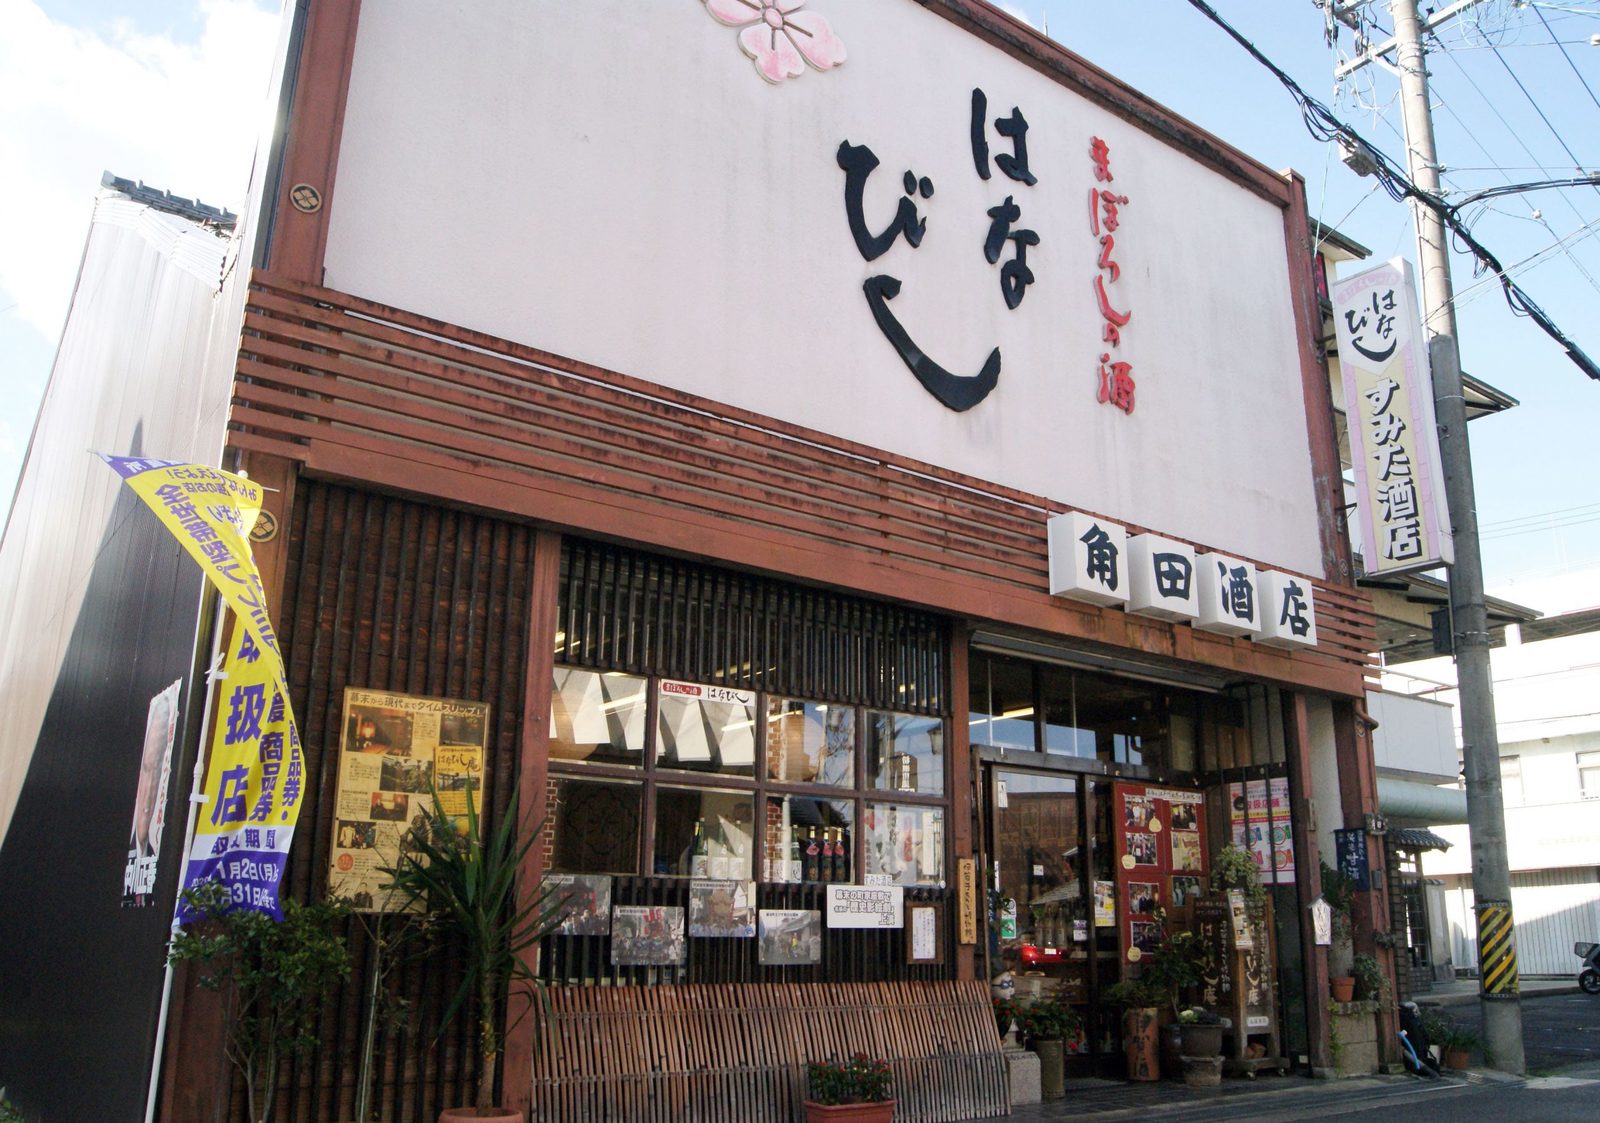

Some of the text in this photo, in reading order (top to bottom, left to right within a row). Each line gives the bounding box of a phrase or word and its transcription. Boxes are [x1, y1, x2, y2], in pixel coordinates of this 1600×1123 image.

[1364, 376, 1424, 561] すみた酒店
[1079, 522, 1312, 638] 角田酒店
[707, 687, 750, 703] はなびし
